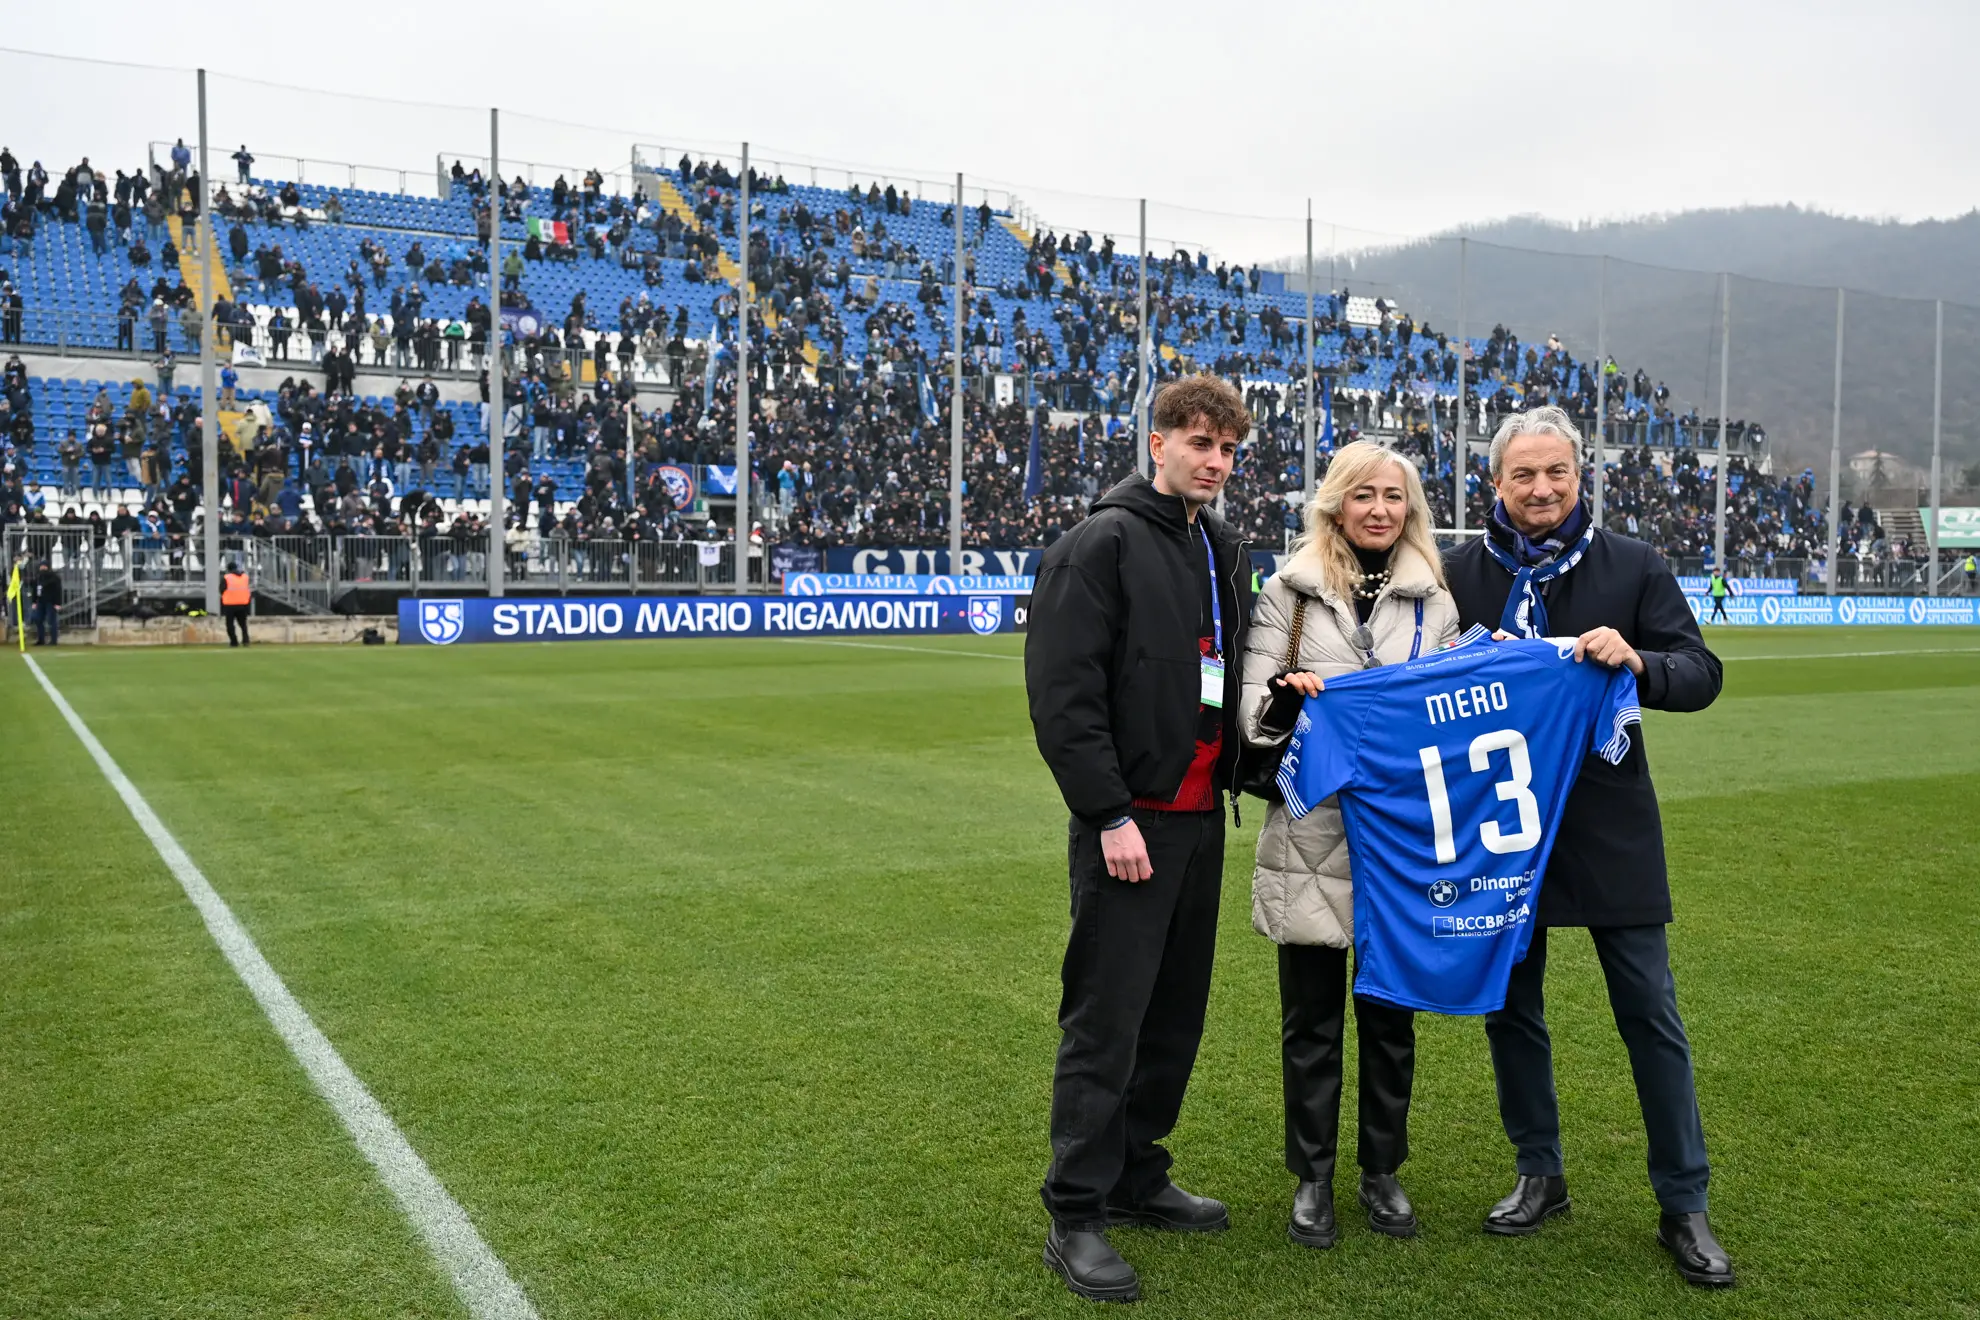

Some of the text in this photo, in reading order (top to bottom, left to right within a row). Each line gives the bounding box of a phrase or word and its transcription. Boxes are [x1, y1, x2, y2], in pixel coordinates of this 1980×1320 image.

[852, 549, 1030, 576] CURV
[826, 574, 917, 588] OLIMPIA
[960, 575, 1031, 589] OLIMPI
[1677, 577, 1711, 588] LIMPI
[1744, 579, 1793, 589] OLIMPIA
[1702, 596, 1757, 608] OMPIA
[1782, 597, 1832, 608] OLIMPIA
[1857, 597, 1905, 608] OLIMPIA
[1927, 598, 1973, 608] OLIMPIA
[493, 600, 939, 635] STADIO MARIO RIGAMONTI
[1014, 607, 1028, 625] 0
[1782, 613, 1833, 624] SPLENDID
[1857, 613, 1905, 624] SPLENDID
[1927, 613, 1973, 624] SPLENDID
[1425, 681, 1508, 725] MERO
[1418, 728, 1542, 865] 13
